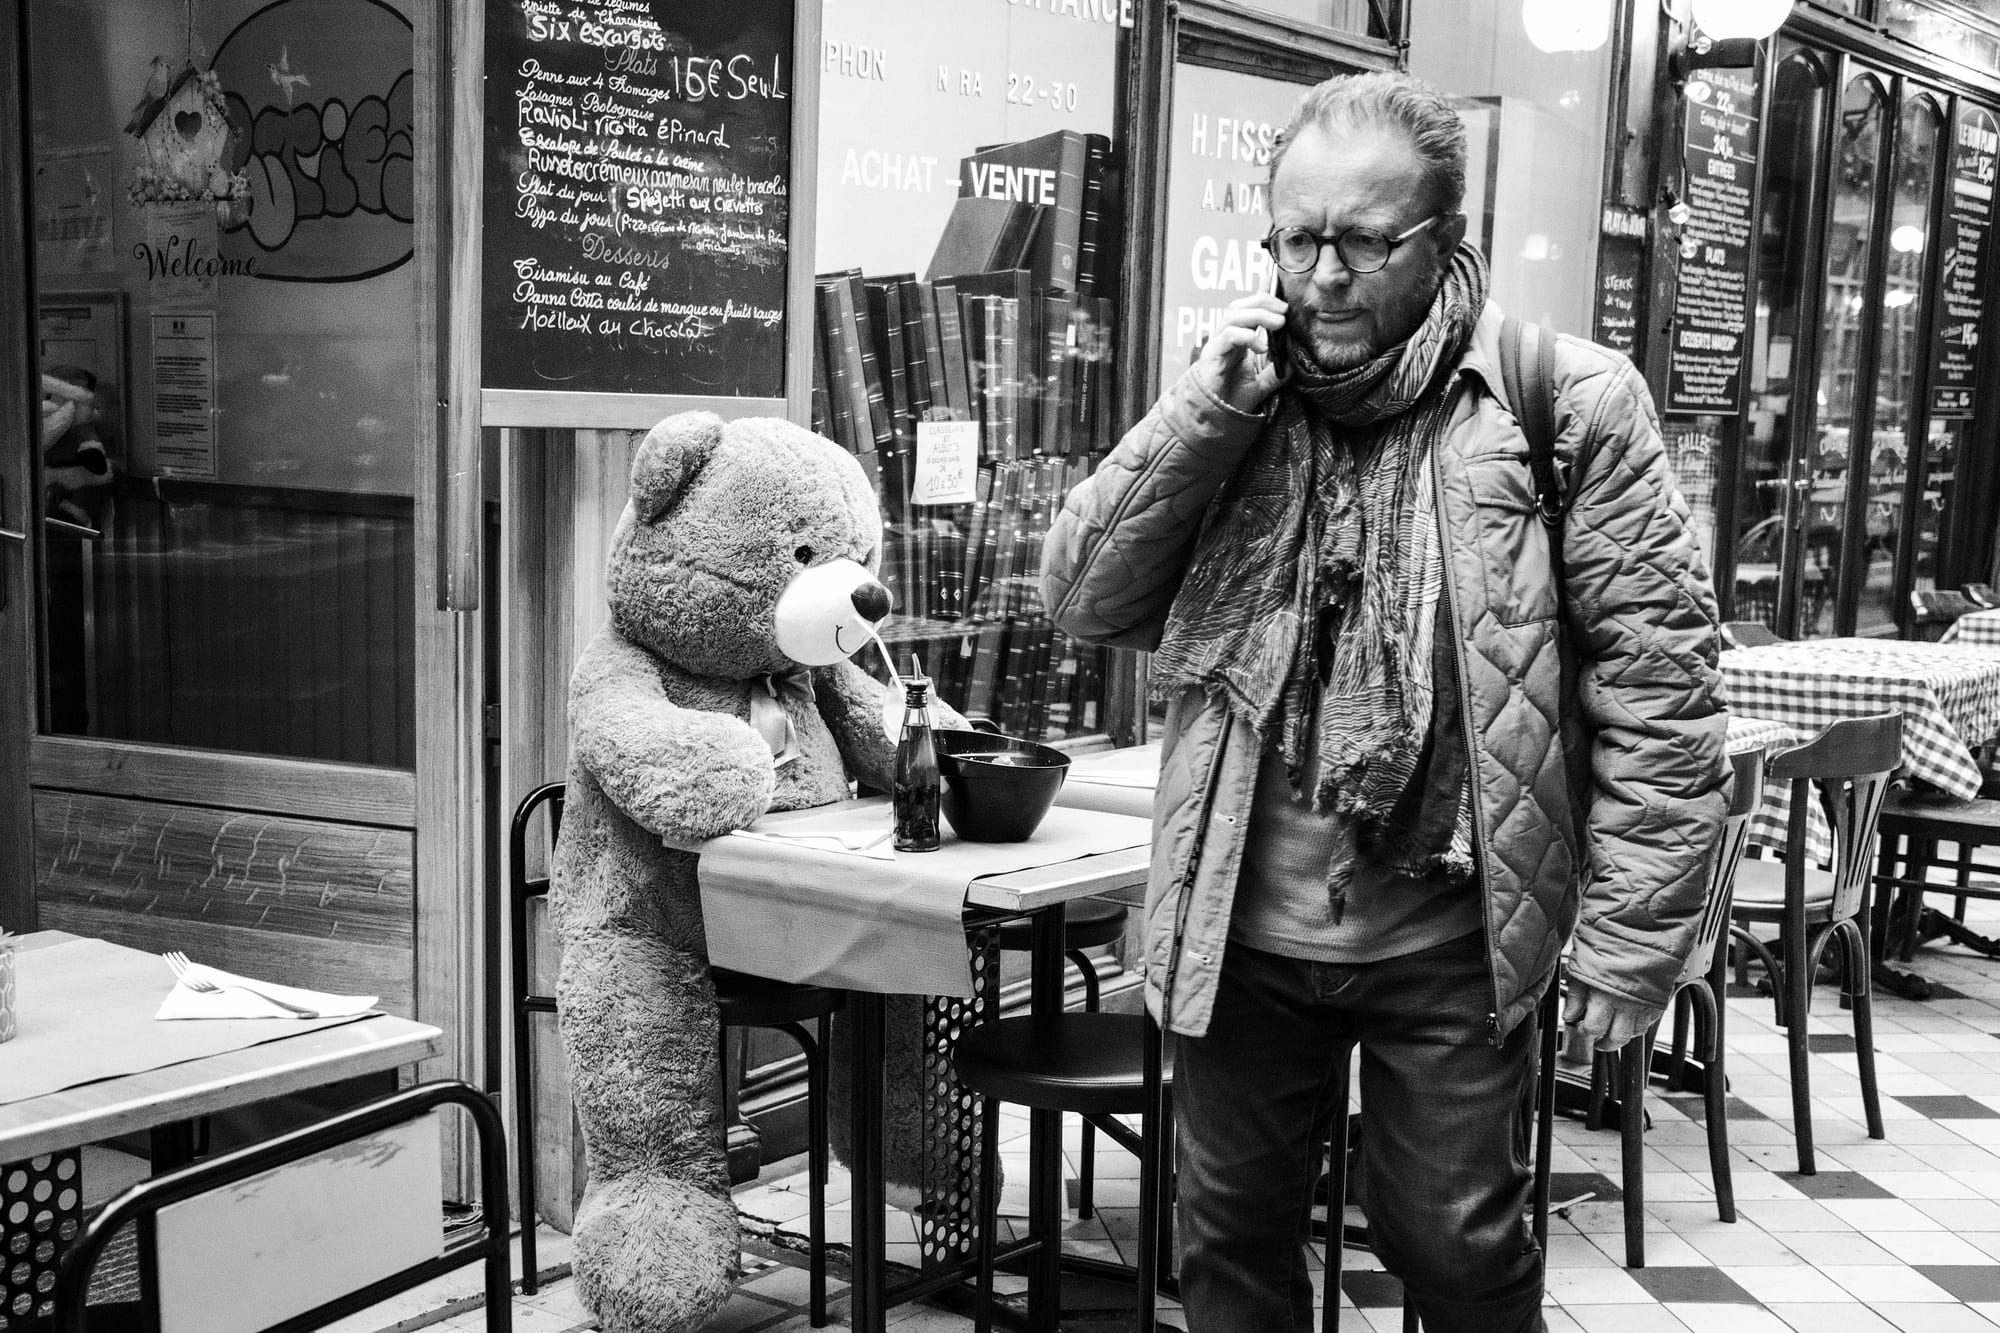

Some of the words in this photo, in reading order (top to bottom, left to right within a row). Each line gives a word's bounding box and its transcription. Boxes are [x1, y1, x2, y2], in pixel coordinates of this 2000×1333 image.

[567, 6, 587, 20] de
[531, 15, 571, 42] Six
[579, 22, 667, 51] escargots
[604, 45, 657, 76] Plats
[518, 58, 564, 83] Penne
[566, 75, 592, 86] aux
[593, 72, 604, 89] 4
[609, 75, 670, 104] Fromages
[1006, 73, 1077, 113] 22-30
[515, 81, 573, 107] Lasagnes
[581, 92, 654, 122] Bolognaise
[519, 127, 583, 157] Escalope
[584, 139, 598, 155] de
[655, 149, 670, 166] la
[516, 171, 555, 196] Plat
[556, 184, 575, 199] du
[574, 185, 607, 208] jour
[689, 197, 711, 213] aux
[651, 170, 710, 192] parmesan
[841, 149, 938, 193] ACHAT
[970, 162, 1056, 205] VENTE
[515, 193, 557, 229] Pizza
[560, 208, 579, 224] du
[580, 208, 613, 232] jour
[133, 235, 260, 281] Welcome
[582, 232, 670, 269] Desserts
[513, 258, 590, 285] Tiramisu
[595, 273, 612, 285] au
[619, 271, 650, 296] Café
[513, 281, 567, 306] Panna
[570, 287, 603, 309] Cotta
[607, 294, 641, 311] coulis
[643, 297, 659, 312] de
[660, 302, 708, 323] mangue
[709, 306, 722, 316] ou
[722, 299, 751, 324] fruits
[599, 319, 620, 335] au
